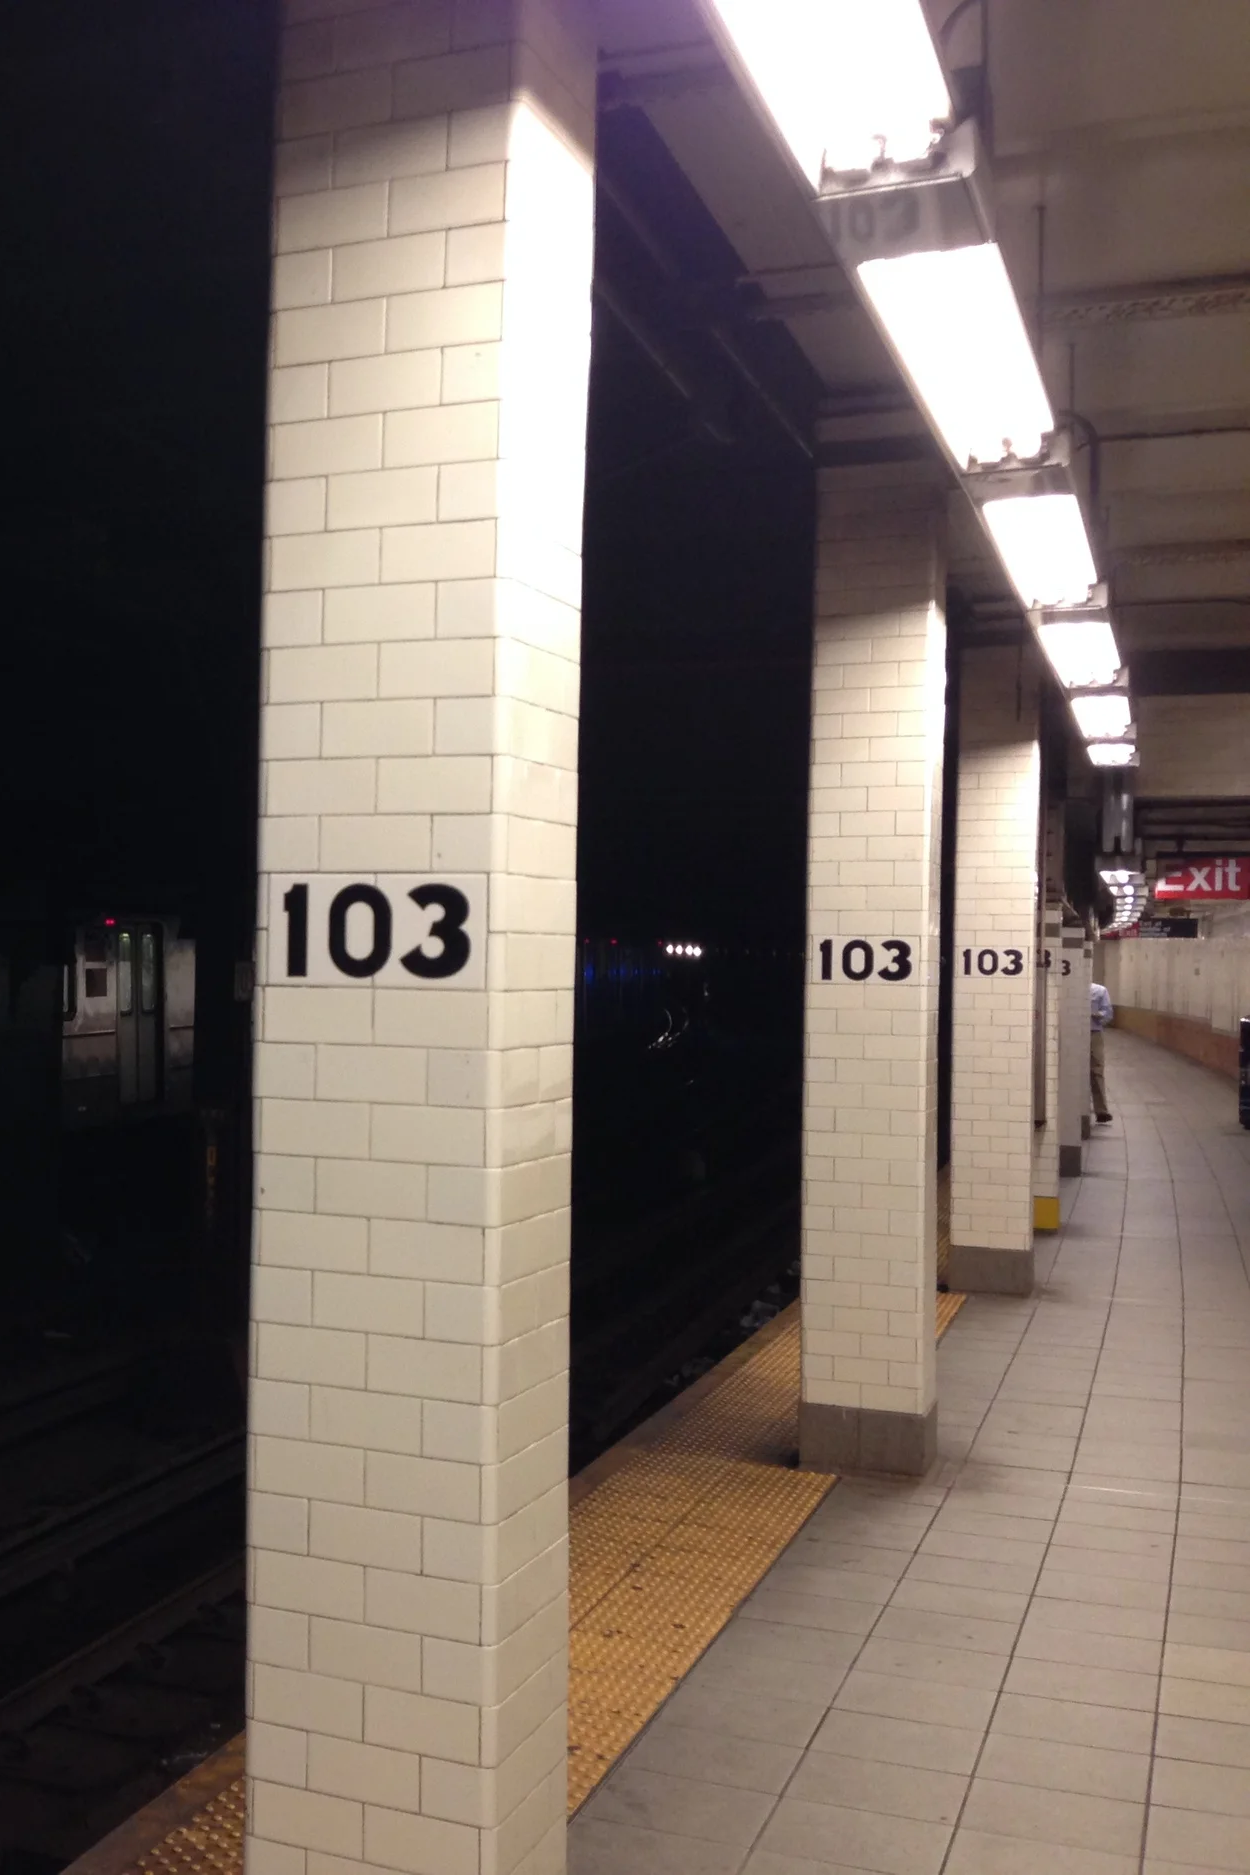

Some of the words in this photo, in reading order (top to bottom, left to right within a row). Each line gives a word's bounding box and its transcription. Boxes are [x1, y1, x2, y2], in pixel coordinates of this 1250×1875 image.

[1156, 859, 1241, 891] Exit
[284, 883, 471, 979] 103
[819, 939, 912, 981] 103
[962, 948, 1024, 976] 103
